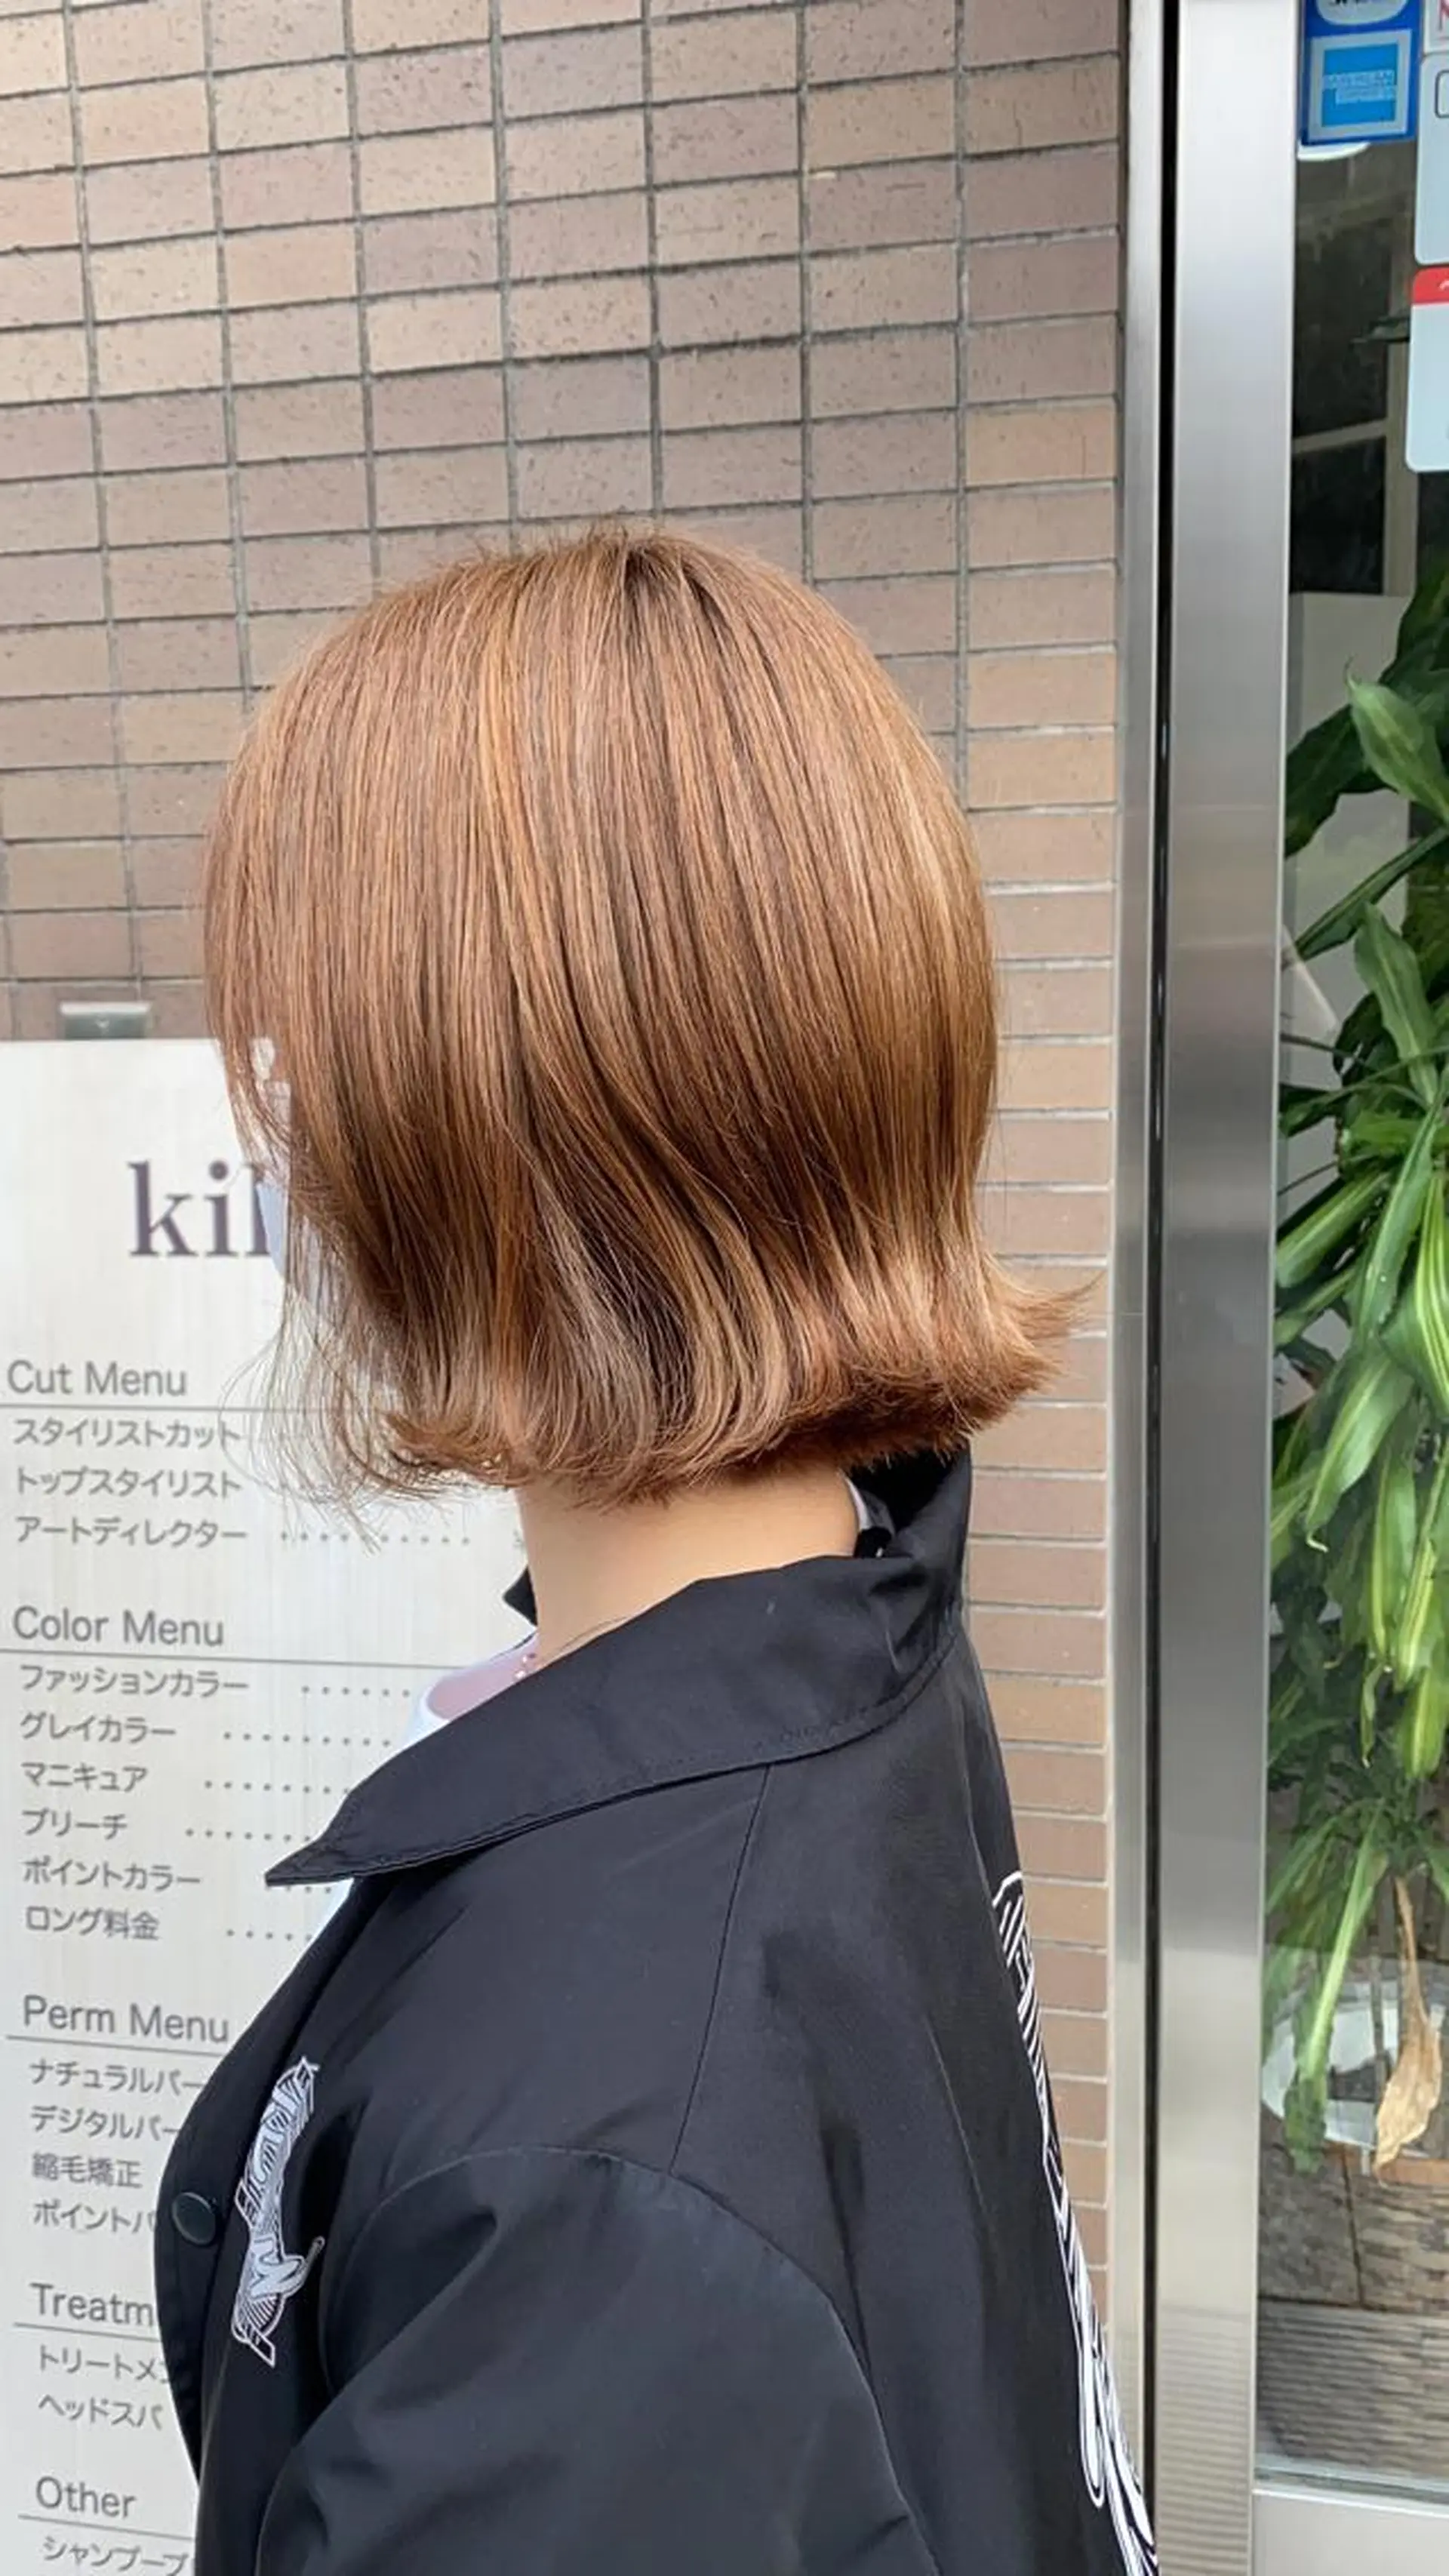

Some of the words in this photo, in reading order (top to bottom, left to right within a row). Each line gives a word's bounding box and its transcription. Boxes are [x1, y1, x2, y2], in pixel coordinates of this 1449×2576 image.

[7, 1359, 72, 1395] Cut
[85, 1361, 187, 1396] Menu
[14, 1417, 241, 1448] スタイリストカット
[17, 1465, 242, 1498] トップスタイリスト
[15, 1516, 248, 1548] アートディレクター
[13, 1605, 109, 1642] Color
[122, 1610, 223, 1646] Menu
[20, 1664, 249, 1697] ファッションカラー
[20, 1711, 176, 1743] グレイカラー
[21, 1762, 148, 1793] マニキュア
[22, 1854, 201, 1891] ポイントカラー
[26, 1906, 159, 1940] ロング料金
[23, 1994, 115, 2033] Perm
[129, 2002, 229, 2042] Menu
[32, 2152, 143, 2188] 縮毛矯正
[29, 2282, 152, 2326] Treatm
[35, 2476, 136, 2517] Other
